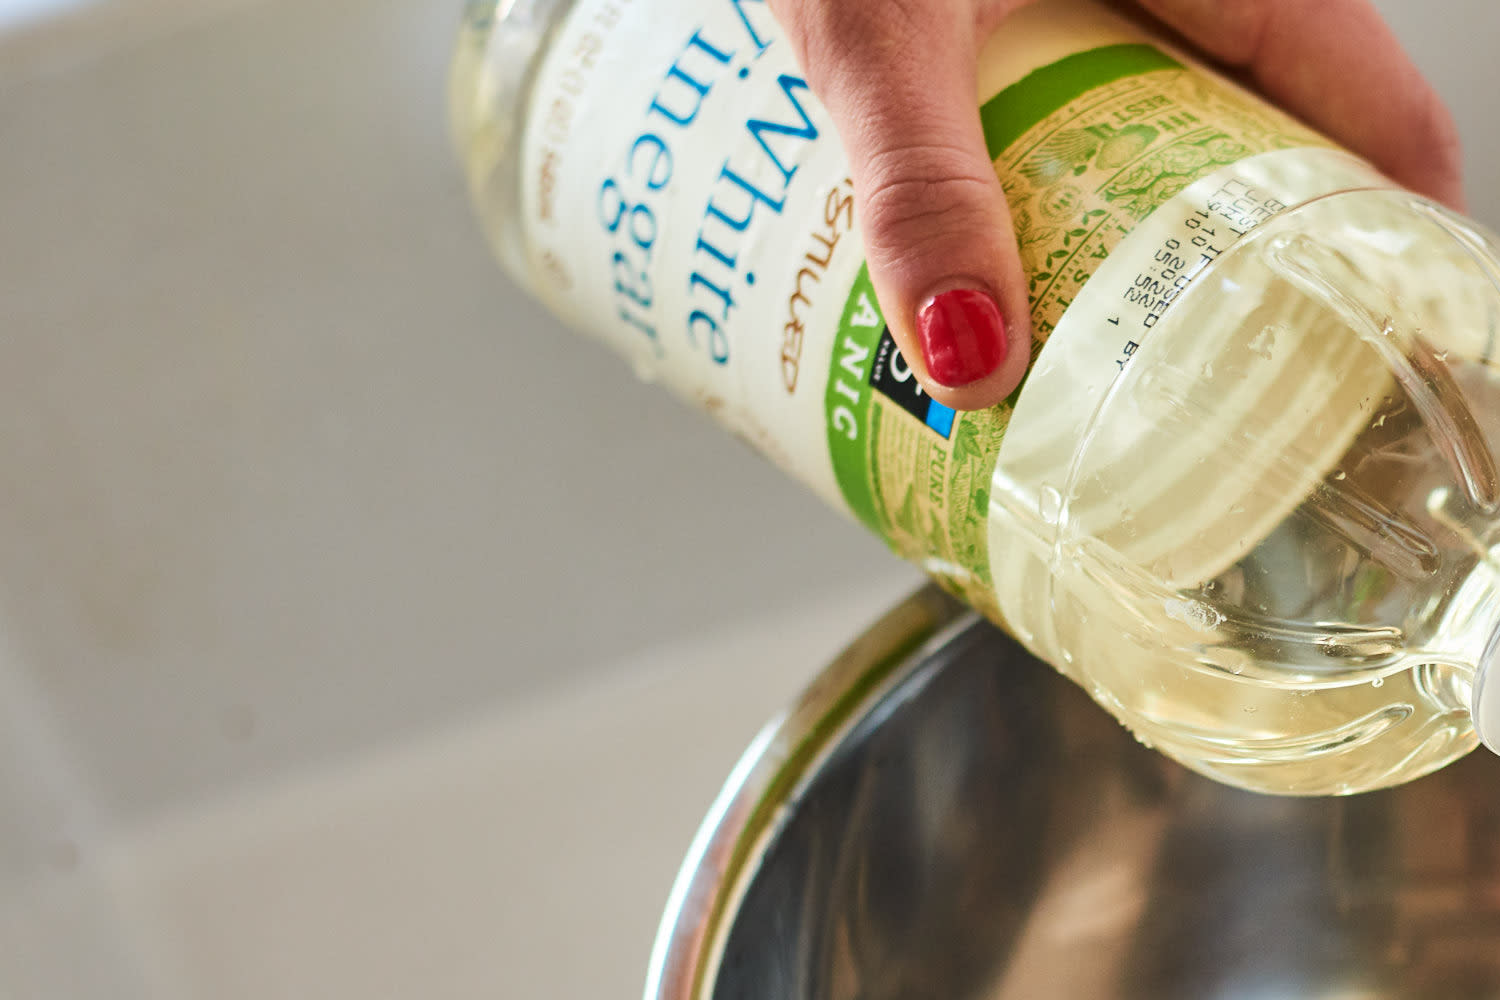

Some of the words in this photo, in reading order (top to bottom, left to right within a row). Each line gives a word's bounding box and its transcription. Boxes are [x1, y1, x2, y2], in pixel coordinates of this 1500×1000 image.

[688, 74, 818, 366] White
[1191, 226, 1216, 247] 10
[1229, 198, 1288, 239] BEST
[1038, 224, 1136, 337] TASTE
[1123, 238, 1181, 302] 05:52
[1200, 245, 1223, 265] IF
[780, 178, 854, 395] STILLED
[1137, 257, 1185, 308] 2022
[1143, 275, 1191, 328] USED
[1107, 316, 1120, 326] 1
[833, 292, 880, 440] ANIC
[1116, 340, 1139, 371] BY
[930, 443, 947, 509] PURE
